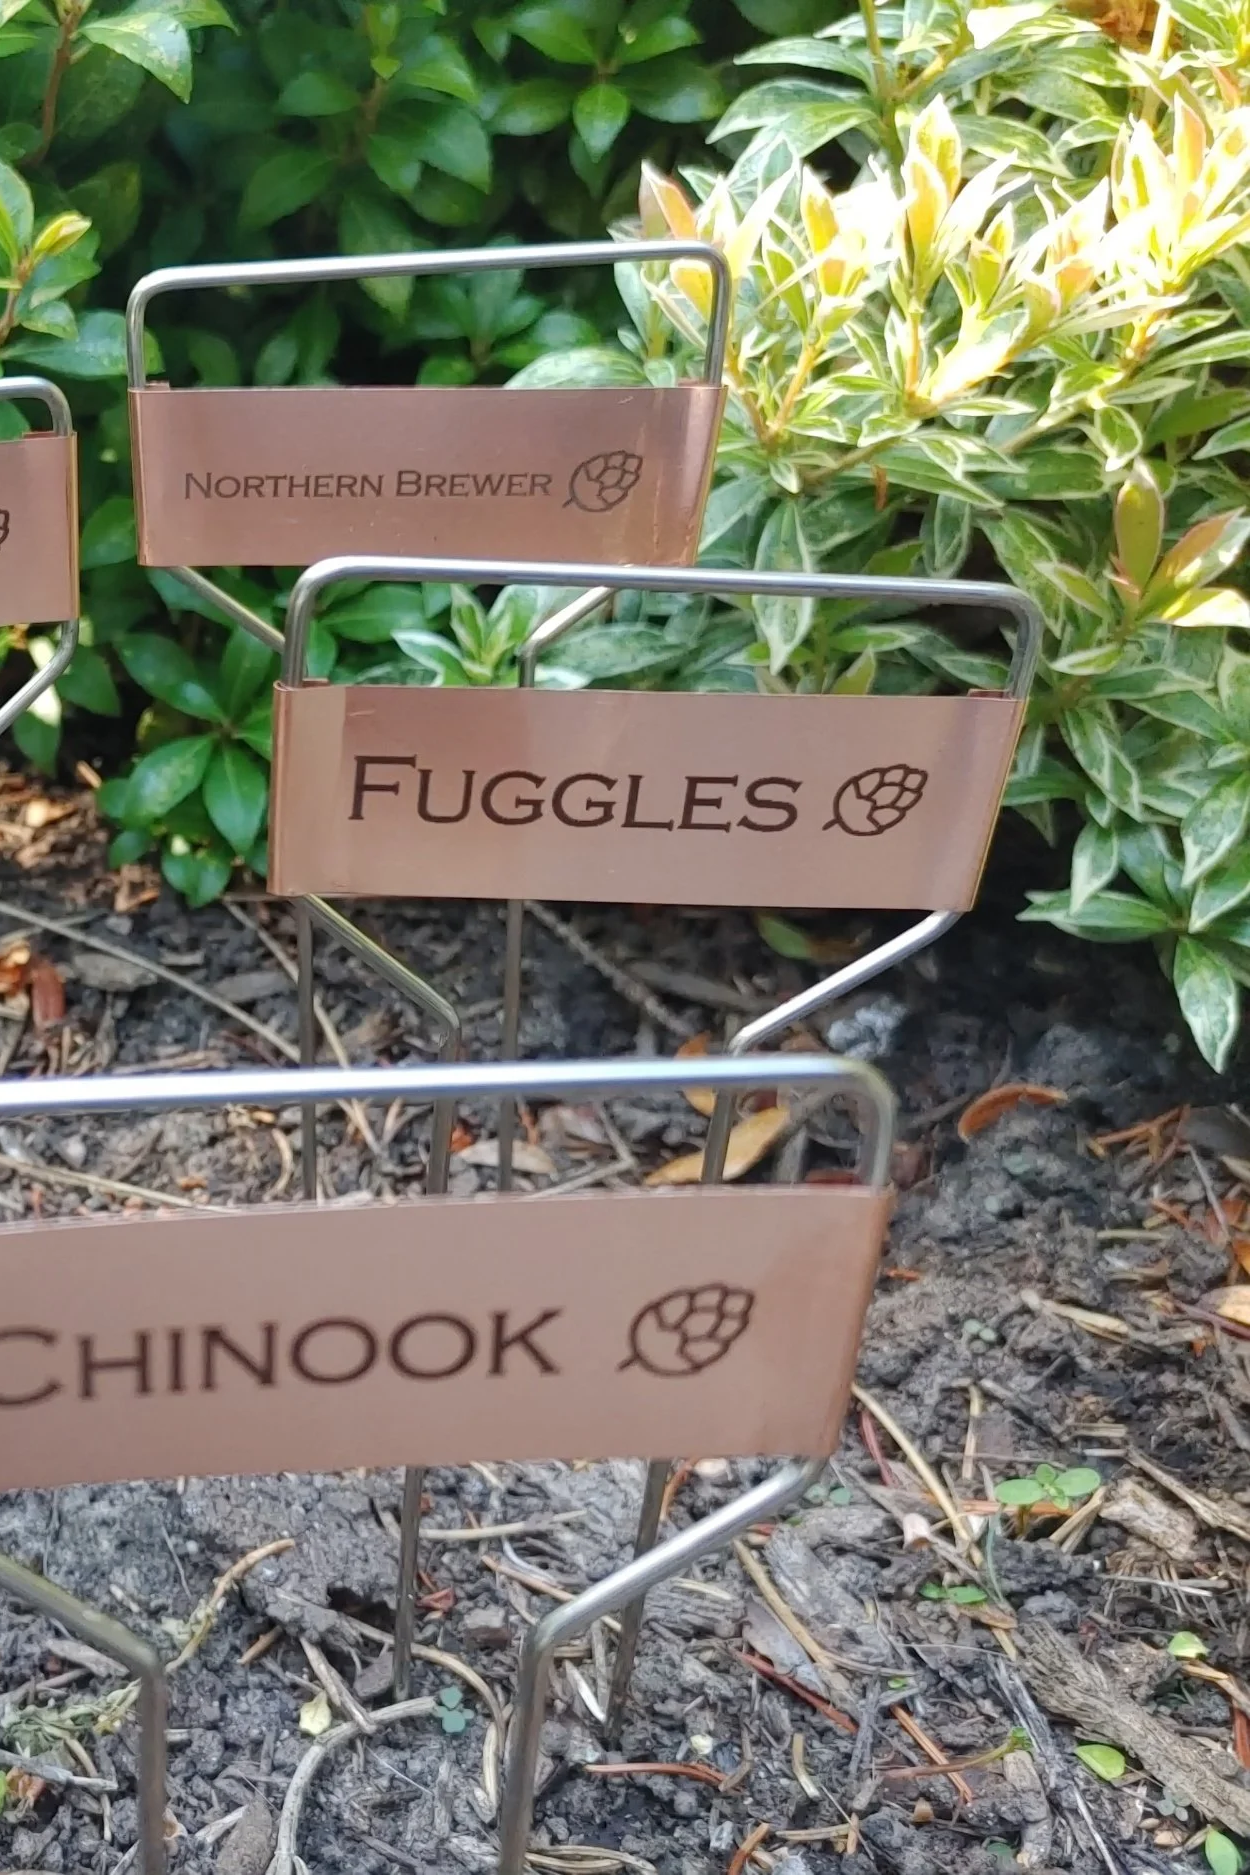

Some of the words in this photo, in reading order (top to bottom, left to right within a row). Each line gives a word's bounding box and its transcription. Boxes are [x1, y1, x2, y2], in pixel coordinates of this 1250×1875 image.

[185, 471, 385, 500] NORTHERN
[396, 469, 552, 498] BREWER
[348, 754, 803, 833] FUGGLES
